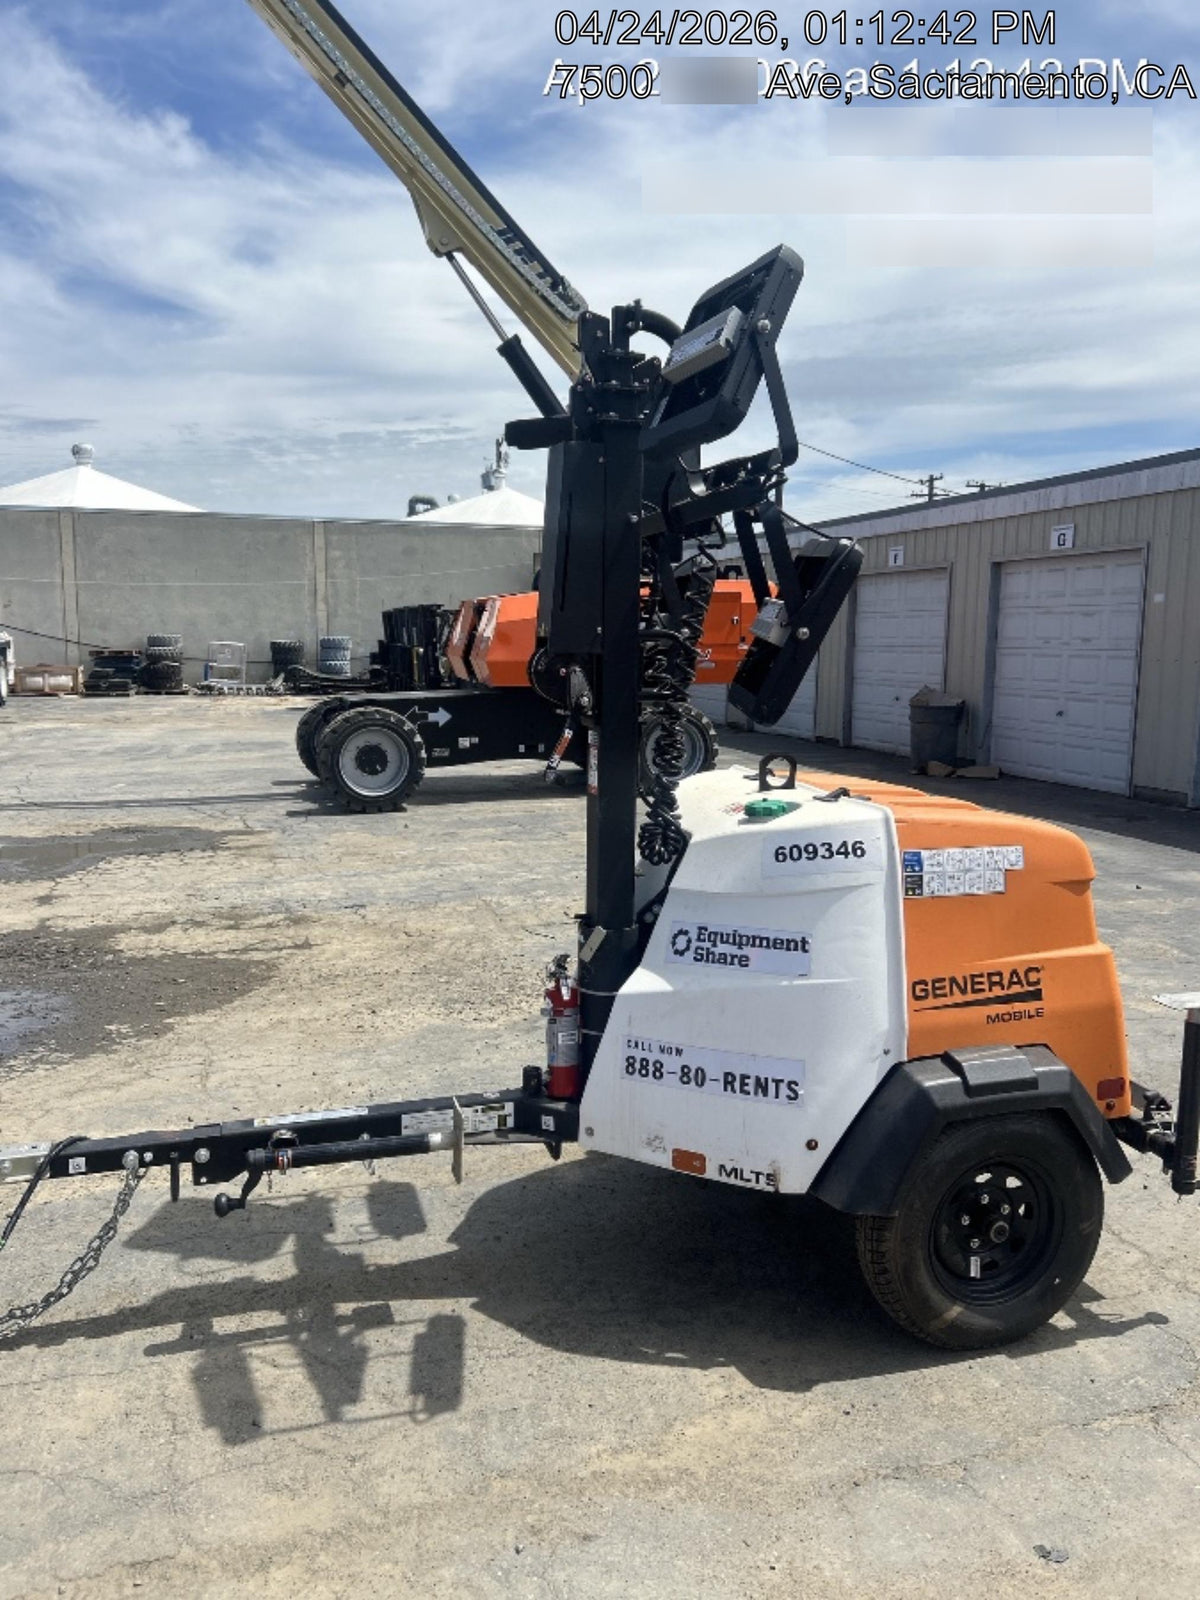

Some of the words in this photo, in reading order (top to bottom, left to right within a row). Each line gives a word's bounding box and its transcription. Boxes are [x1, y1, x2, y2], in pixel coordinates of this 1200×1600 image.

[774, 840, 867, 863] 609346
[695, 926, 810, 953] Equipment
[692, 946, 750, 967] Share
[911, 966, 1042, 1001] GENERAC
[986, 1007, 1045, 1024] MOBILE
[627, 1039, 653, 1053] CALL
[659, 1044, 683, 1057] NOW
[625, 1055, 800, 1101] 888-80-RENTS
